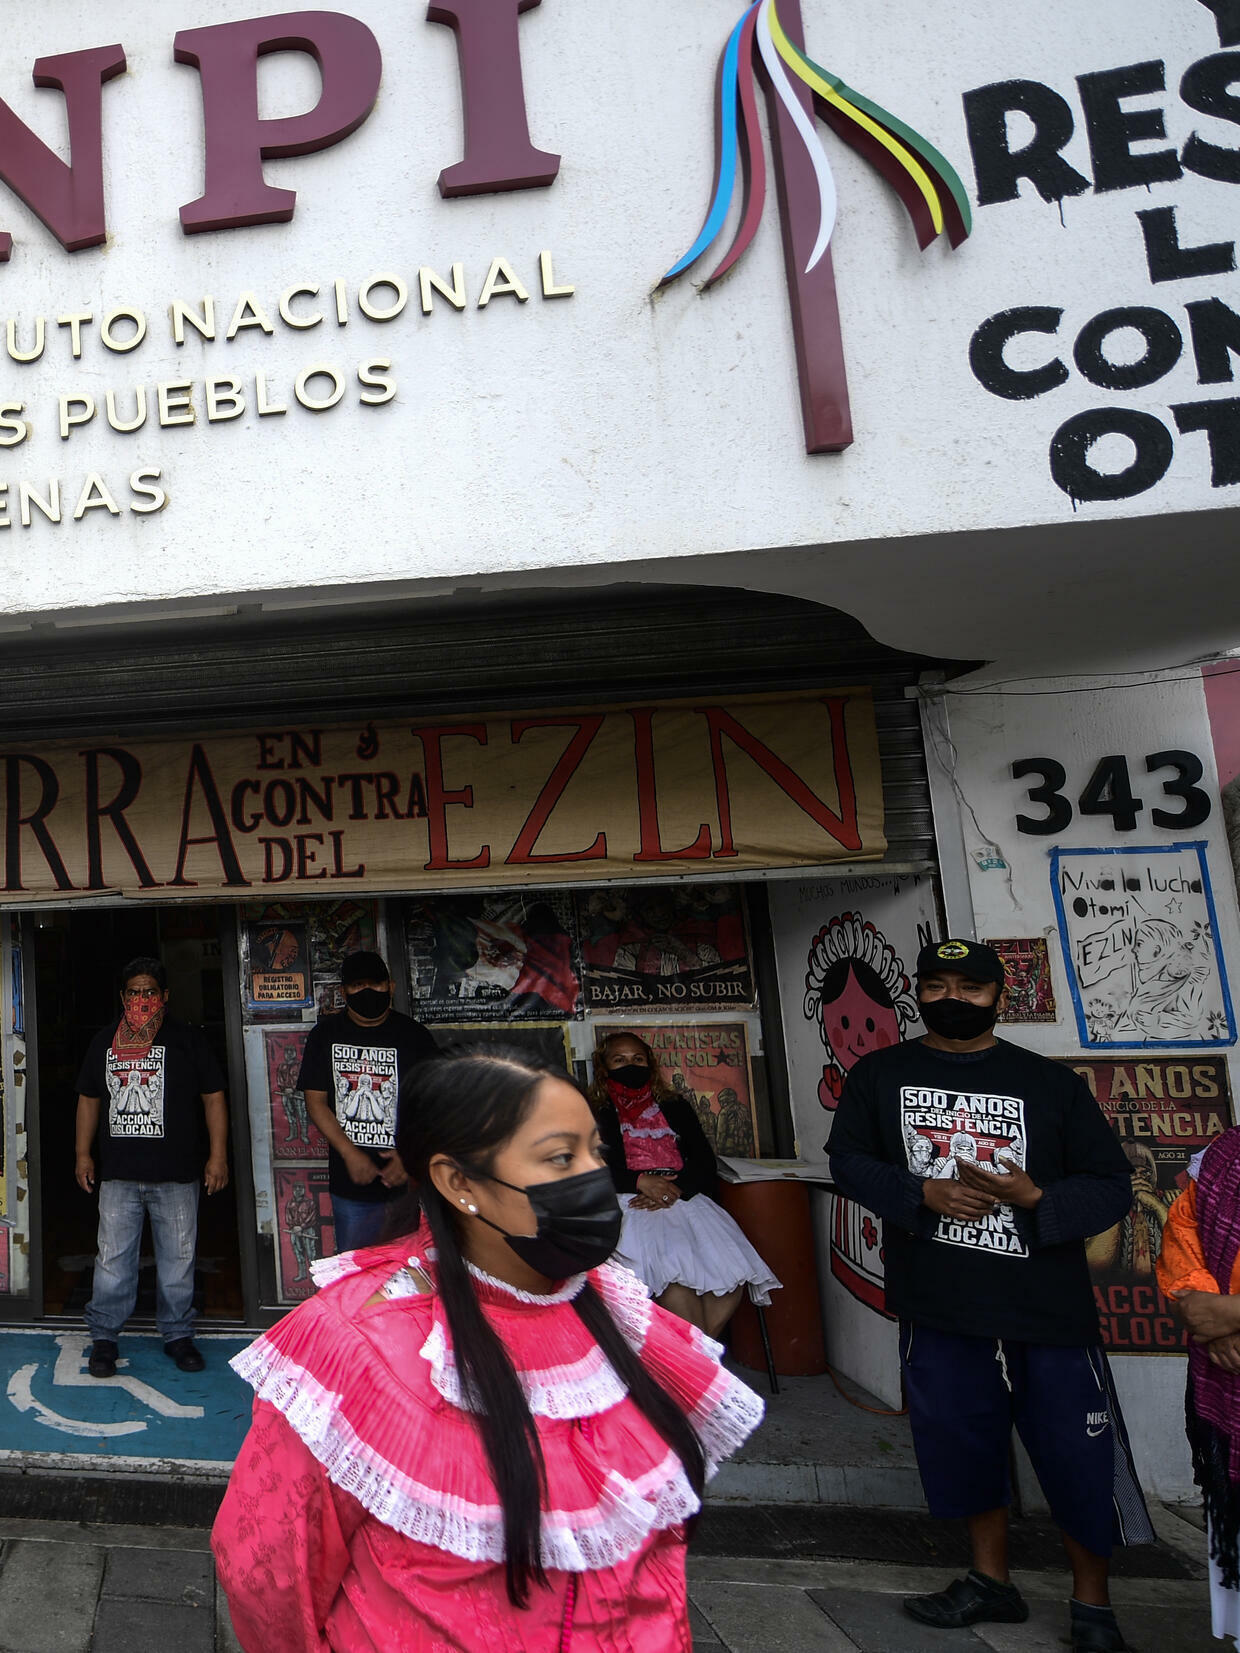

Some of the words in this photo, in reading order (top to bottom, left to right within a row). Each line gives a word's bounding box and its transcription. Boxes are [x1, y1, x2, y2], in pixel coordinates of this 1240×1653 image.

[171, 250, 575, 345] NACIONAL
[58, 357, 399, 440] PUEBLOS
[257, 730, 324, 772] EN
[411, 697, 863, 871] EZLN
[1011, 749, 1212, 835] 343
[230, 772, 429, 834] CONTRA
[258, 829, 366, 884] DEL
[1082, 928, 1133, 967] EZLN
[257, 991, 274, 999] PARA
[590, 984, 655, 1004] BAJAR,
[657, 982, 688, 998] NO
[690, 981, 747, 998] SUBIR
[334, 1046, 359, 1060] 500
[334, 1061, 395, 1075] RESISTENCIA
[1109, 1063, 1220, 1099] AÑOS
[904, 1089, 948, 1108] 500
[953, 1095, 1020, 1119] AÑOS
[930, 1107, 945, 1115] DEL
[1142, 1101, 1159, 1111] DE
[1161, 1101, 1177, 1111] LA
[346, 1132, 396, 1147] SLOCADA
[904, 1111, 1023, 1139] RESISTENCIA
[1109, 1112, 1226, 1137] TENCIA
[1158, 1152, 1175, 1160] AGO
[937, 1222, 1023, 1253] LOCADA
[1092, 1285, 1168, 1316] ACCI
[1086, 1411, 1109, 1425] NIKE
